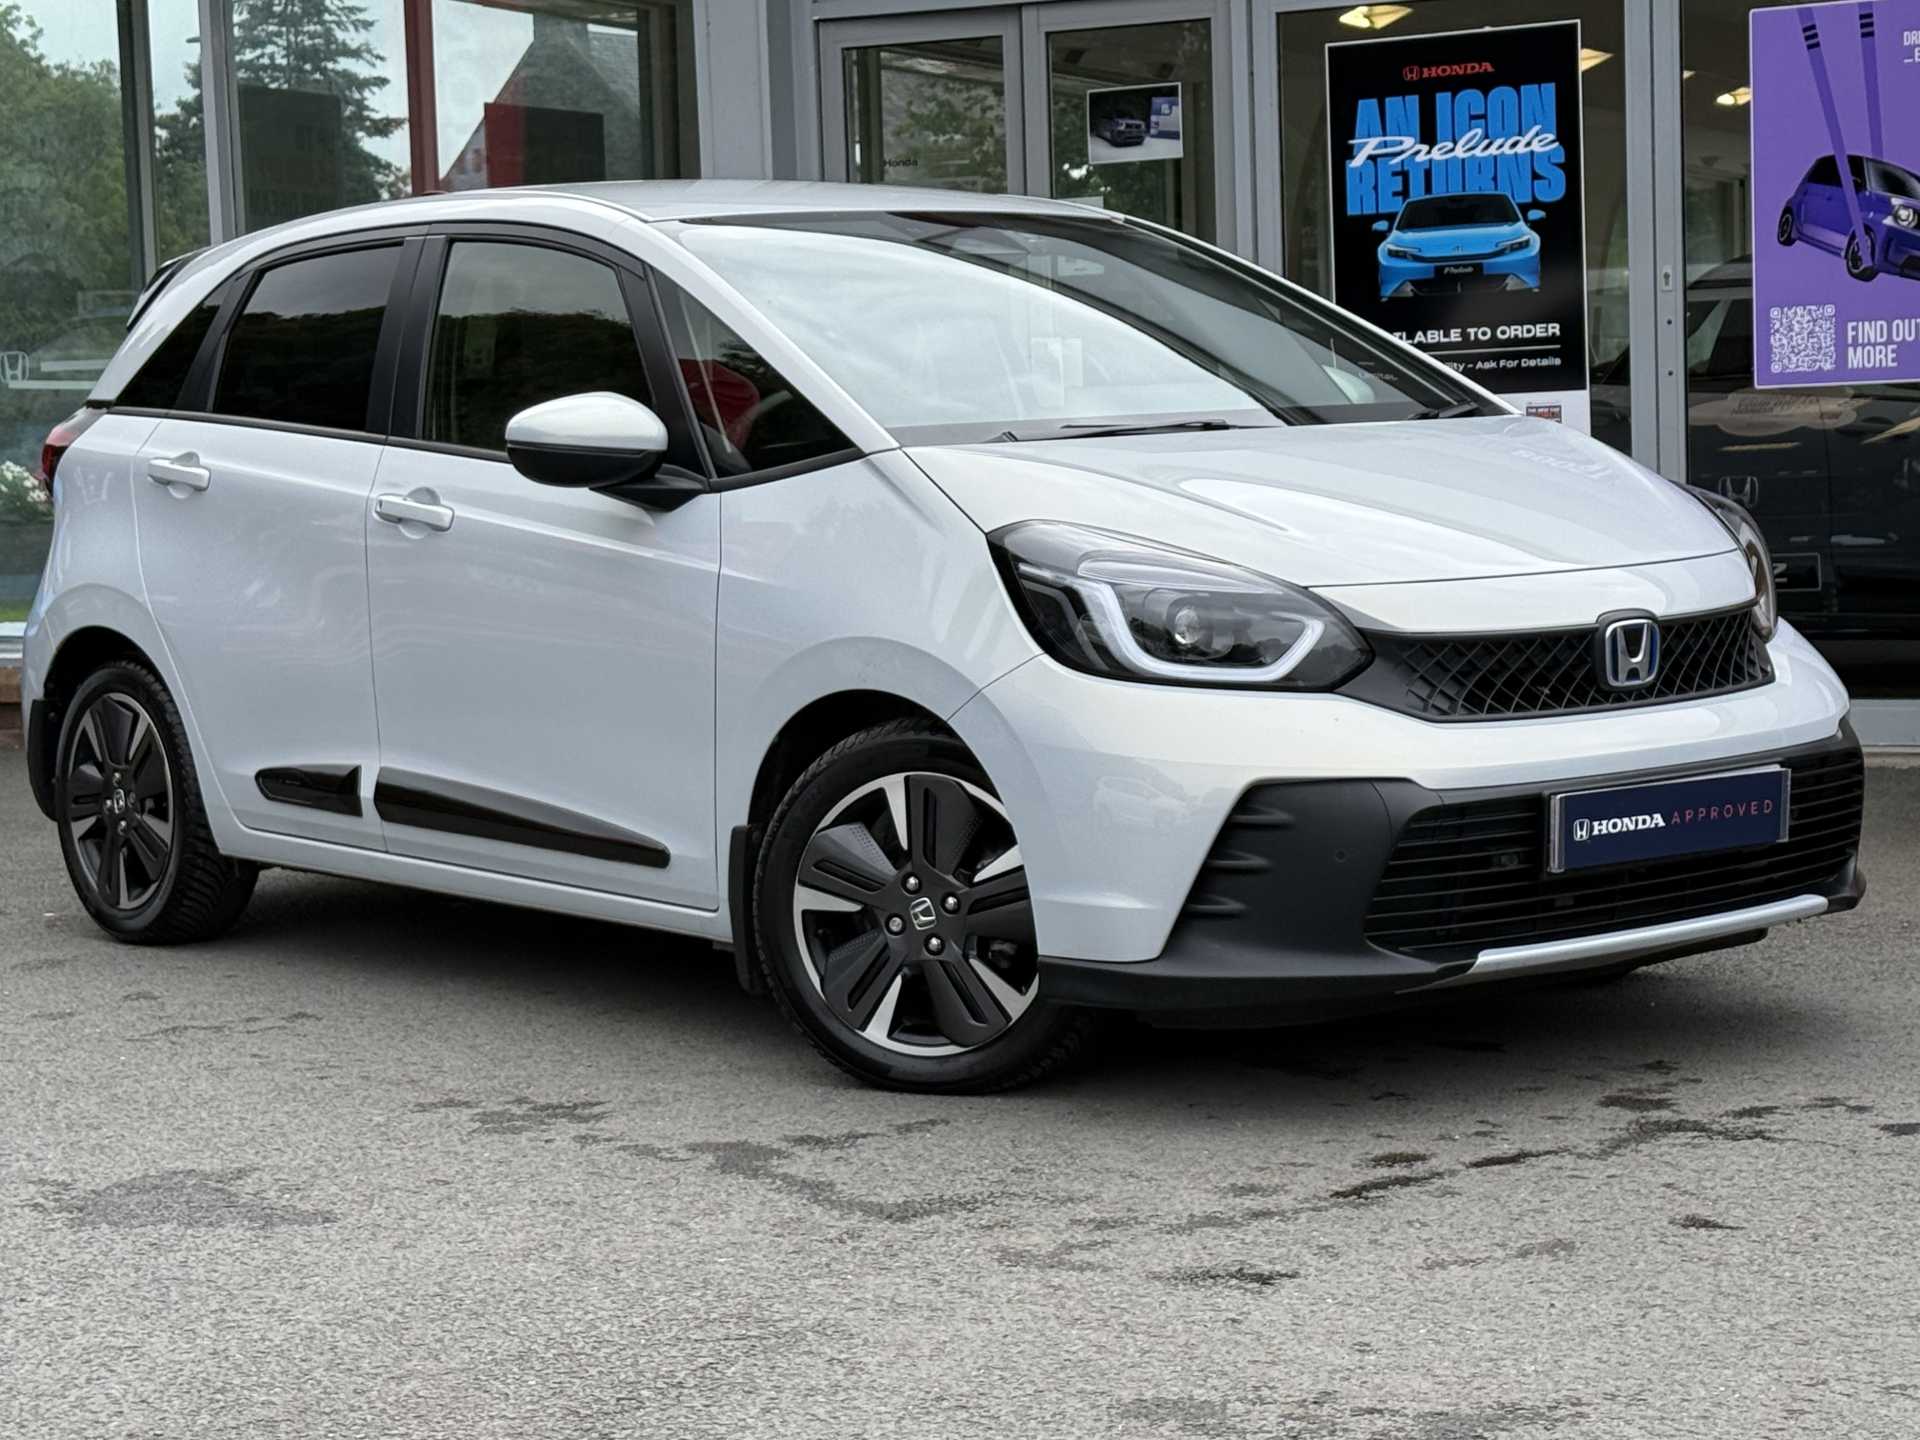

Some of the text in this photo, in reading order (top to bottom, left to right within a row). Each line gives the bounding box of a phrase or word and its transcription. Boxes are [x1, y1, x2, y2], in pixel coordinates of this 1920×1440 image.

[1422, 62, 1495, 78] HONDA
[1353, 82, 1557, 156] AN ICON
[1347, 125, 1560, 168] Prelude
[1346, 146, 1566, 216] RETURNS
[1466, 326, 1491, 341] TO
[1497, 323, 1561, 339] ORDER
[1848, 321, 1887, 344] FIND
[1475, 360, 1497, 369] Ask
[1499, 359, 1519, 368] For
[1521, 356, 1561, 367] Details
[1848, 345, 1898, 369] MORE
[1592, 813, 1666, 836] HONDA
[1671, 799, 1774, 825] APPROVED
